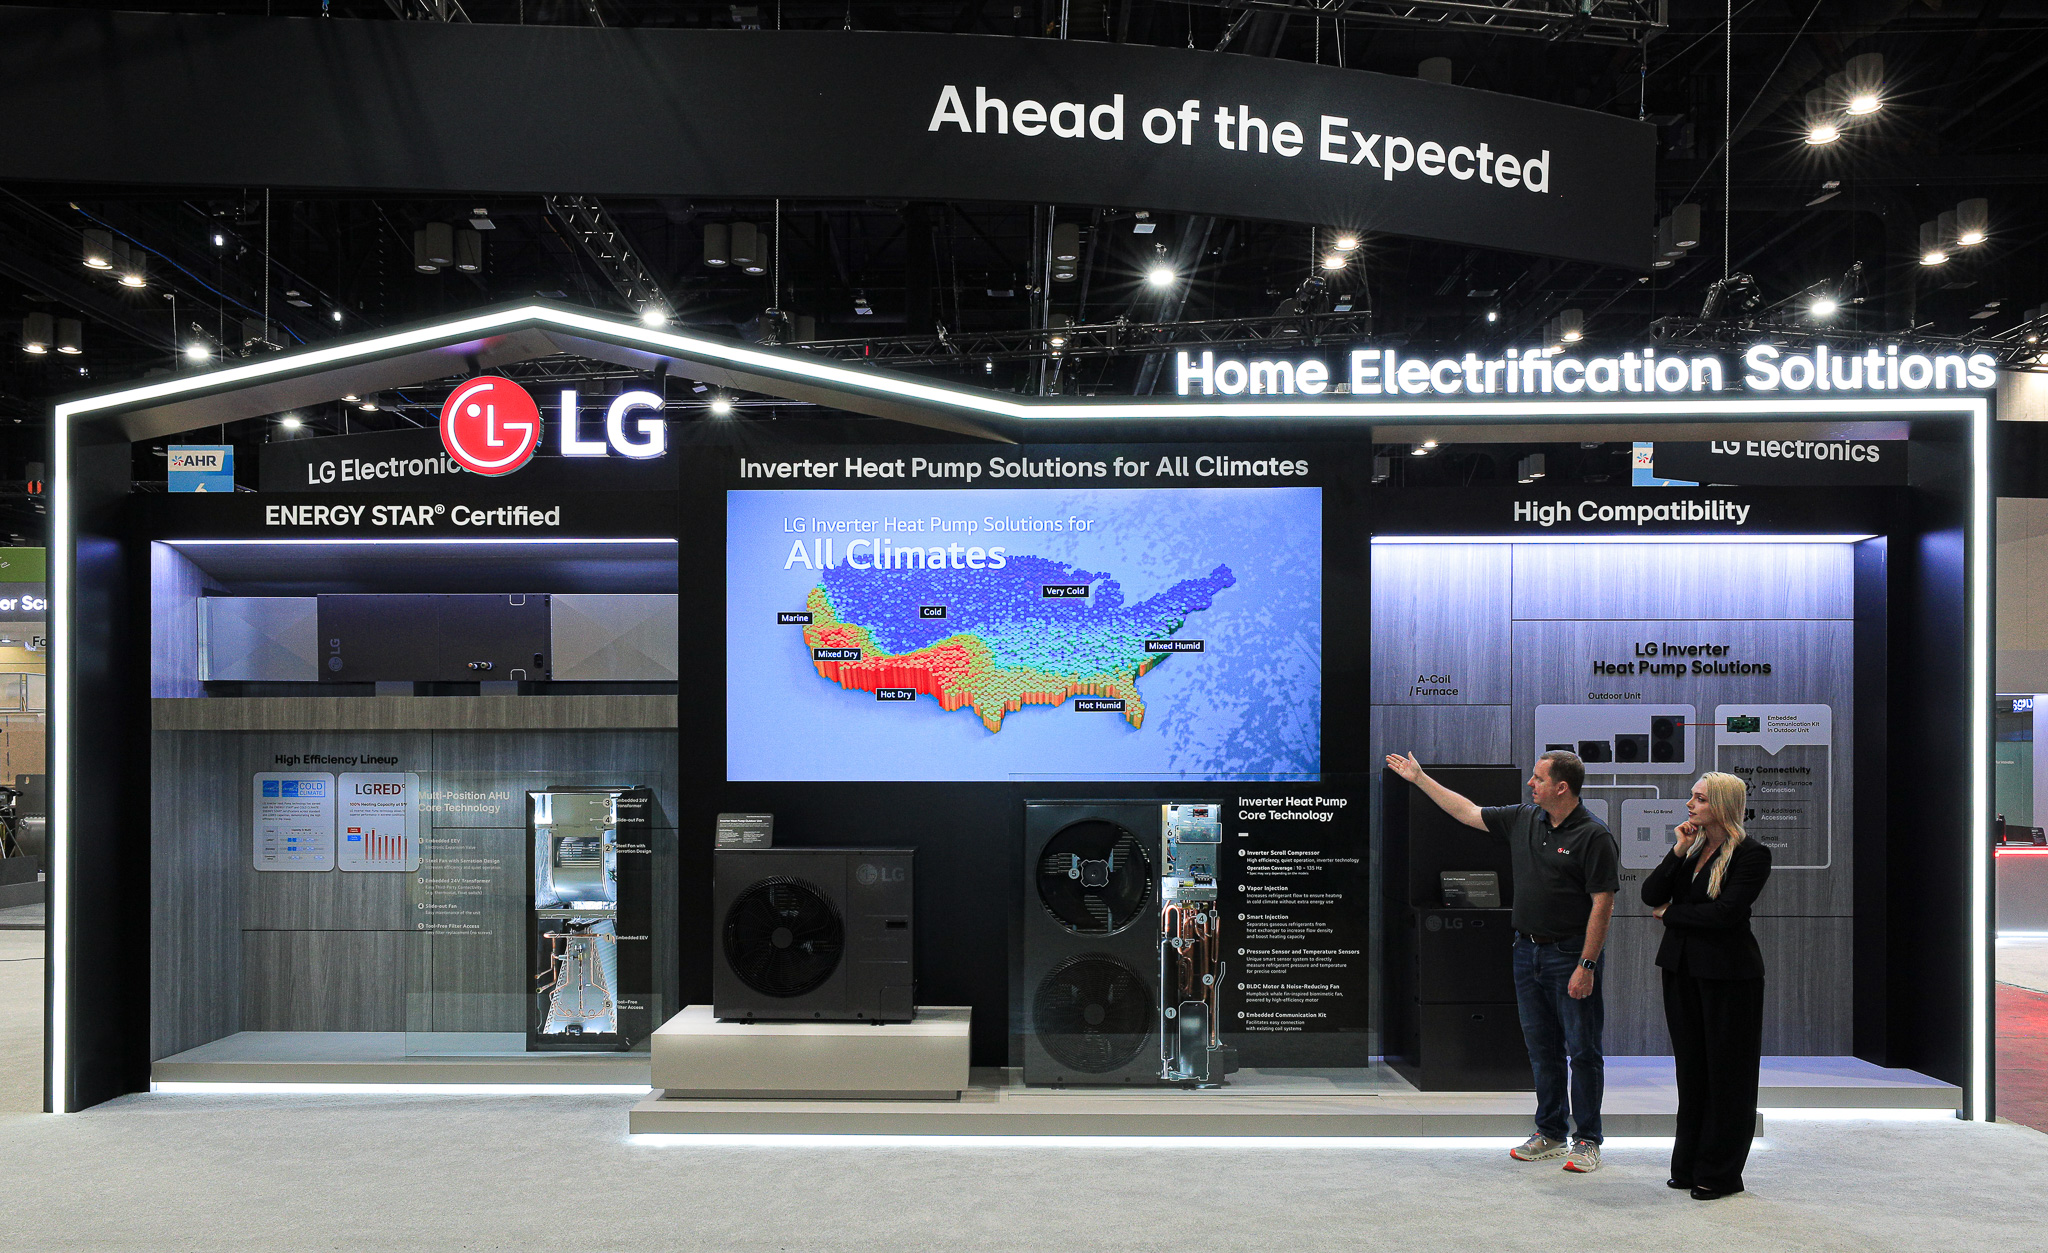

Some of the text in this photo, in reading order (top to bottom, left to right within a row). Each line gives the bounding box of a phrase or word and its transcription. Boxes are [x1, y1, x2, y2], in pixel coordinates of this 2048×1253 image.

[928, 85, 1550, 194] Ahead of the Expected
[1176, 343, 1997, 396] Home Electrification Solutions
[561, 390, 667, 459] LG
[1712, 440, 1880, 463] LG Electronics
[184, 456, 217, 467] AHR
[308, 452, 470, 485] LG Electronic
[740, 456, 1309, 482] Inverter Heat Pump Solutions for All Climates
[266, 504, 560, 526] ENERGY STAR® Certified
[1514, 500, 1750, 527] High Compatibility
[784, 516, 1095, 535] LG Inverter Heat Pump Solutions for
[784, 538, 1007, 570] All Climates
[1046, 588, 1064, 596] Very
[924, 608, 942, 616] Cold
[330, 638, 340, 655] LG
[1149, 642, 1200, 650] Mixed Humid
[1636, 642, 1730, 656] LG Inverter
[844, 651, 858, 660] Dry
[1594, 660, 1772, 678] Heat Pump Solutions
[1418, 675, 1451, 684] A-Coil
[897, 691, 912, 700] Dry
[1416, 687, 1459, 696] Furnace
[1588, 692, 1641, 700] Outdoor Unit
[275, 755, 398, 766] High Efficiency Lineup
[1734, 766, 1811, 774] Easy Connectivity
[419, 792, 510, 800] Multi-Position AHU
[1238, 797, 1348, 808] Inverter Heat Pump
[419, 804, 500, 814] Core Technology
[1238, 810, 1334, 822] Core Technology
[882, 867, 905, 881] LG
[1445, 918, 1463, 929] LG
